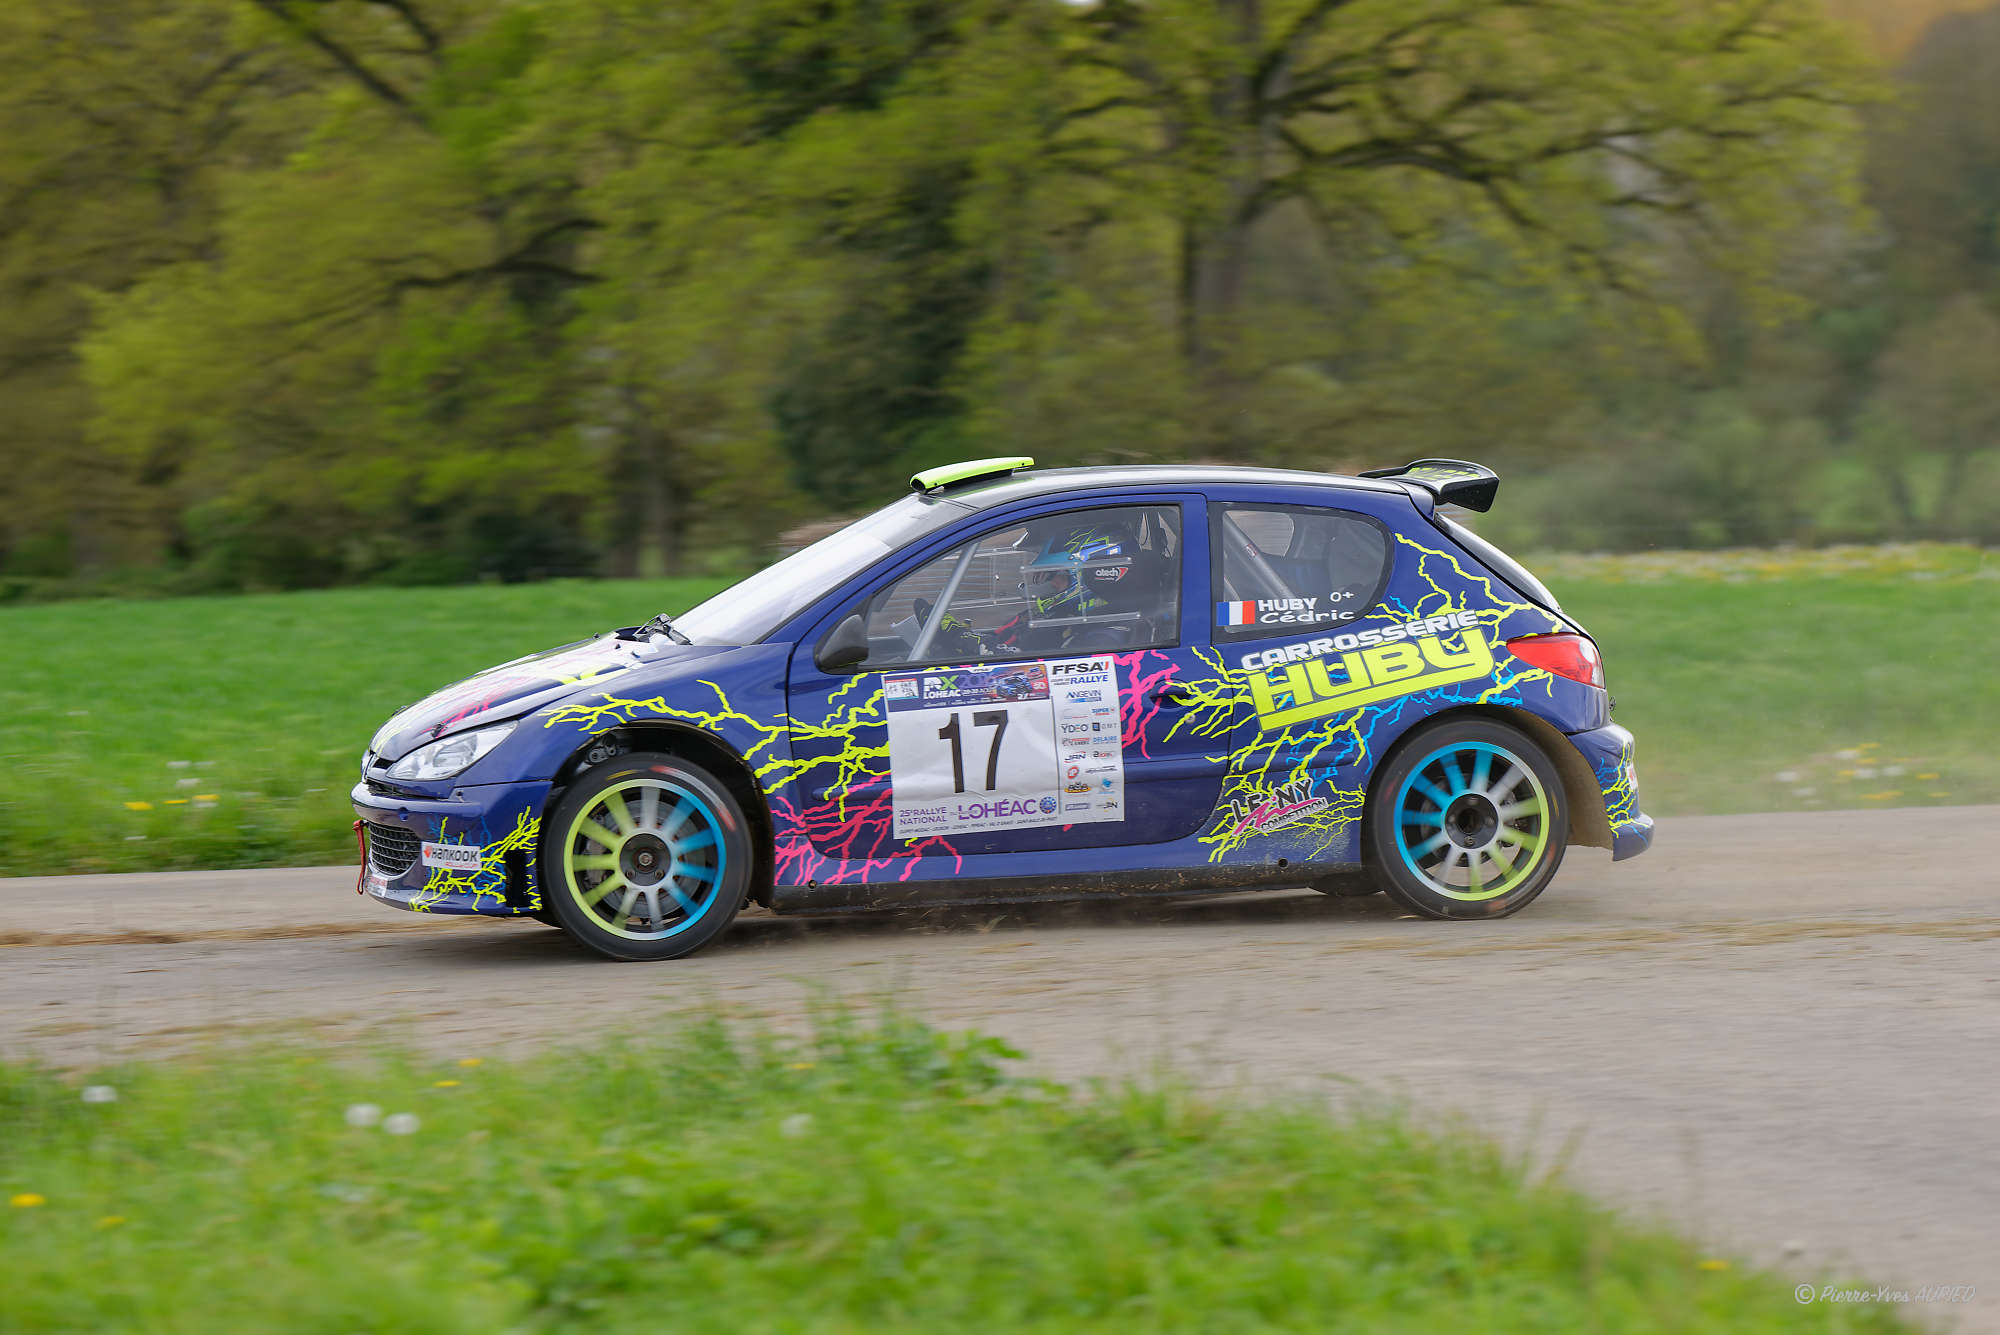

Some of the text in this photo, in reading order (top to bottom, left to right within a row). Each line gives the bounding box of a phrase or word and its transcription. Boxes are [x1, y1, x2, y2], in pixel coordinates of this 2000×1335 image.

[1258, 597, 1317, 613] HUBY
[1259, 609, 1355, 624] Cédric
[1240, 610, 1480, 672] CARROSSERIE
[1052, 662, 1103, 675] FFSA
[1070, 674, 1109, 684] RALLYE
[1247, 627, 1495, 732] HUBY
[923, 689, 961, 700] LOHEAC
[938, 710, 1008, 793] 17
[914, 806, 947, 816] RALLYE
[957, 798, 1037, 820] LOHÉAC
[899, 815, 948, 826] NATIONAL
